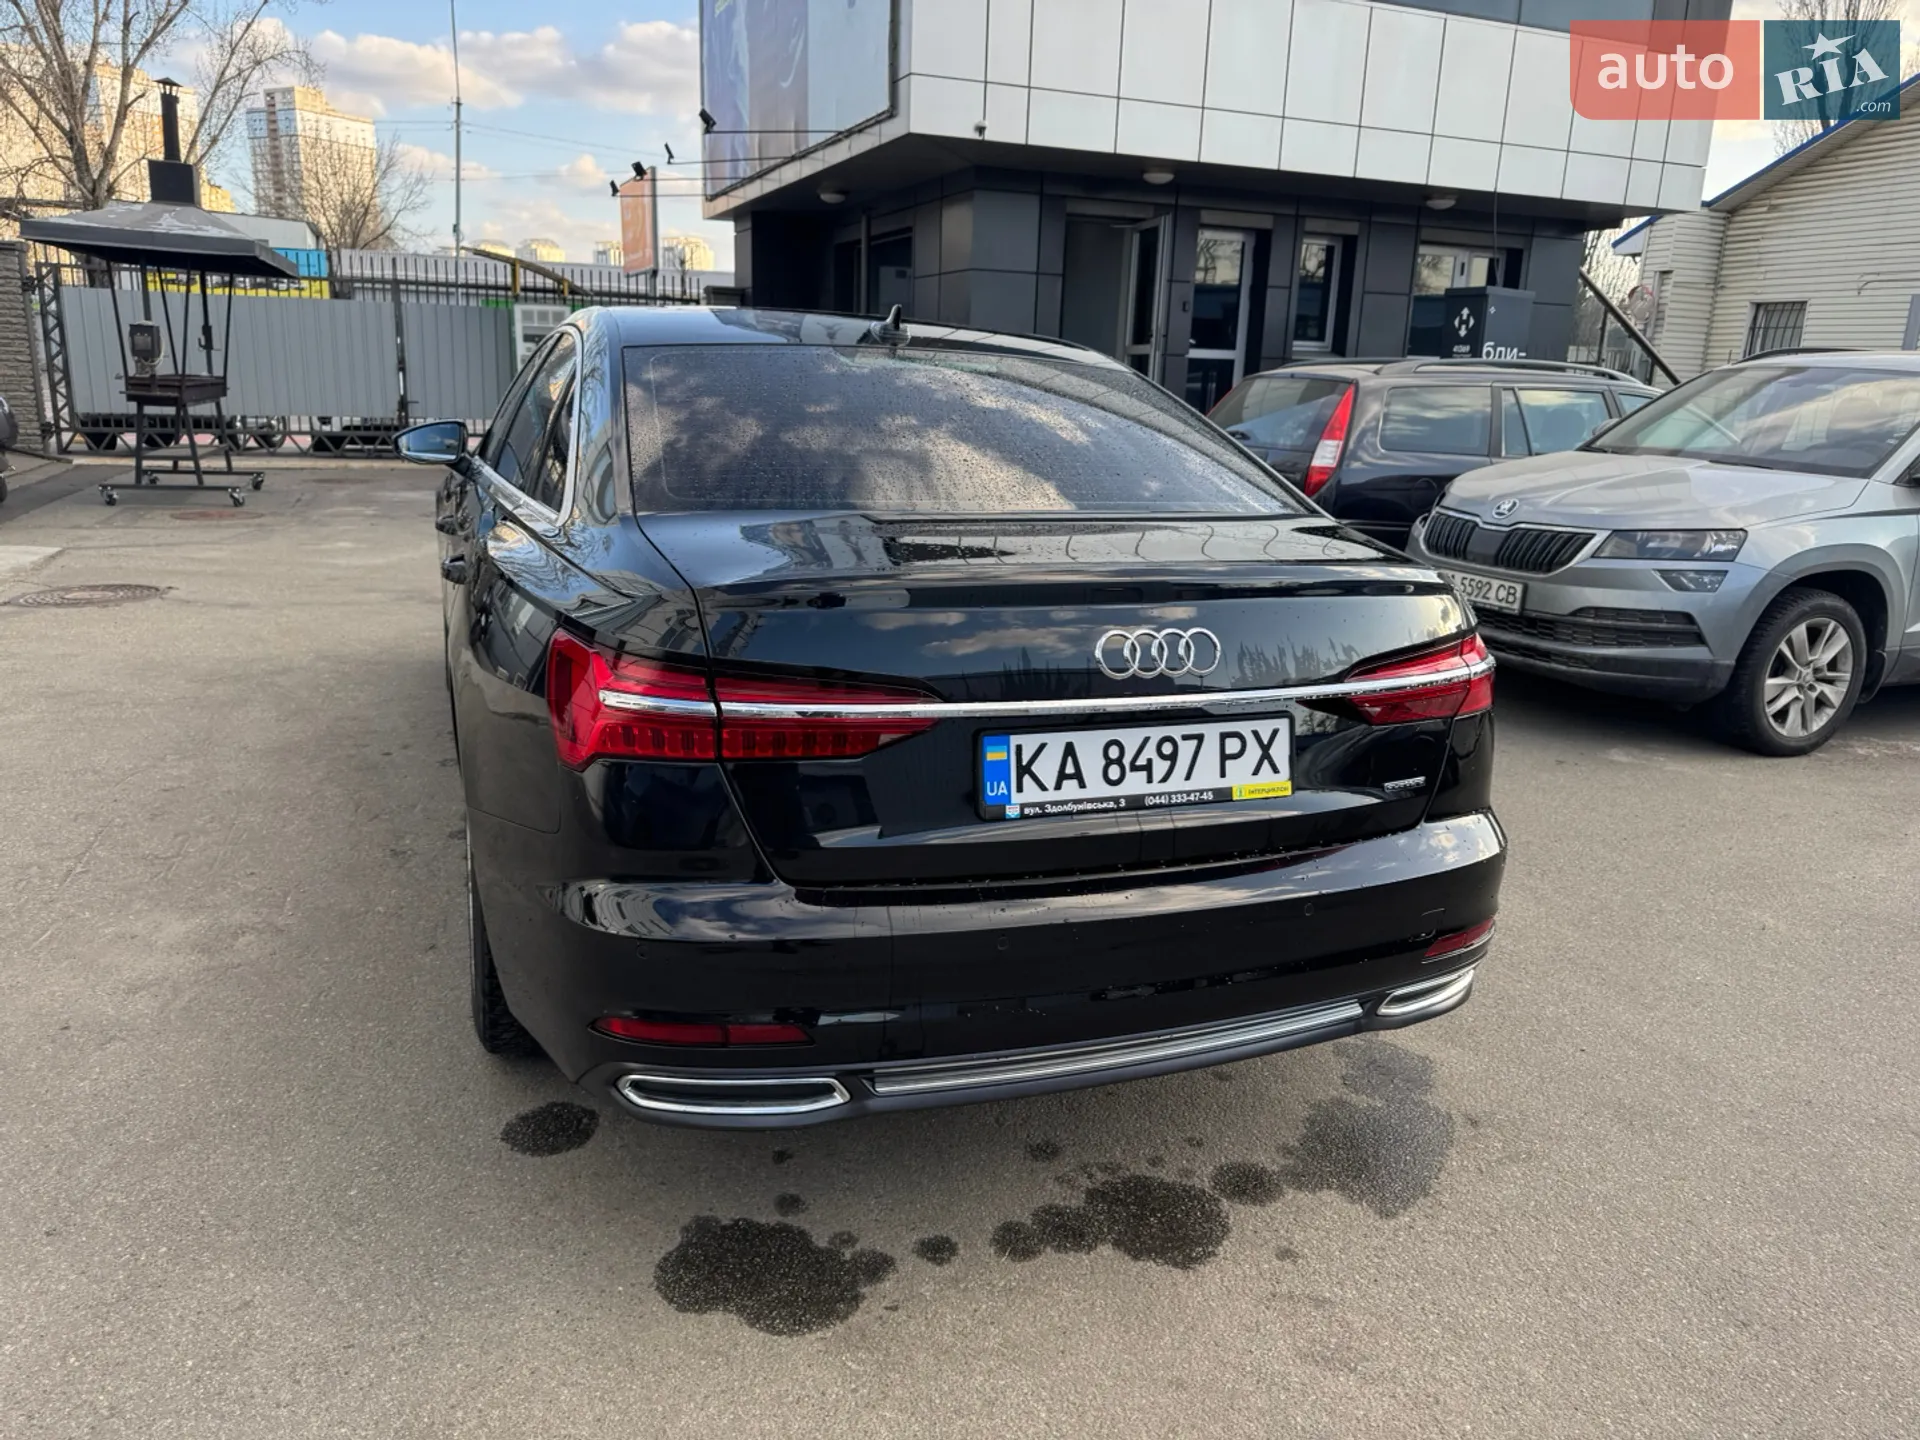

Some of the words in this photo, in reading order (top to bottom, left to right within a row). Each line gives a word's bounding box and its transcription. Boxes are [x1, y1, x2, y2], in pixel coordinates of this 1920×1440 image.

[1482, 341, 1527, 360] бли-
[1460, 577, 1492, 600] 5592
[1495, 584, 1518, 604] CB
[1015, 741, 1087, 794] KA
[1102, 732, 1205, 787] 8497
[1219, 727, 1281, 778] PX
[986, 781, 1009, 796] UA
[1023, 806, 1043, 816] вул.
[1144, 794, 1169, 807] (044)
[1170, 790, 1214, 804] 333-47-45
